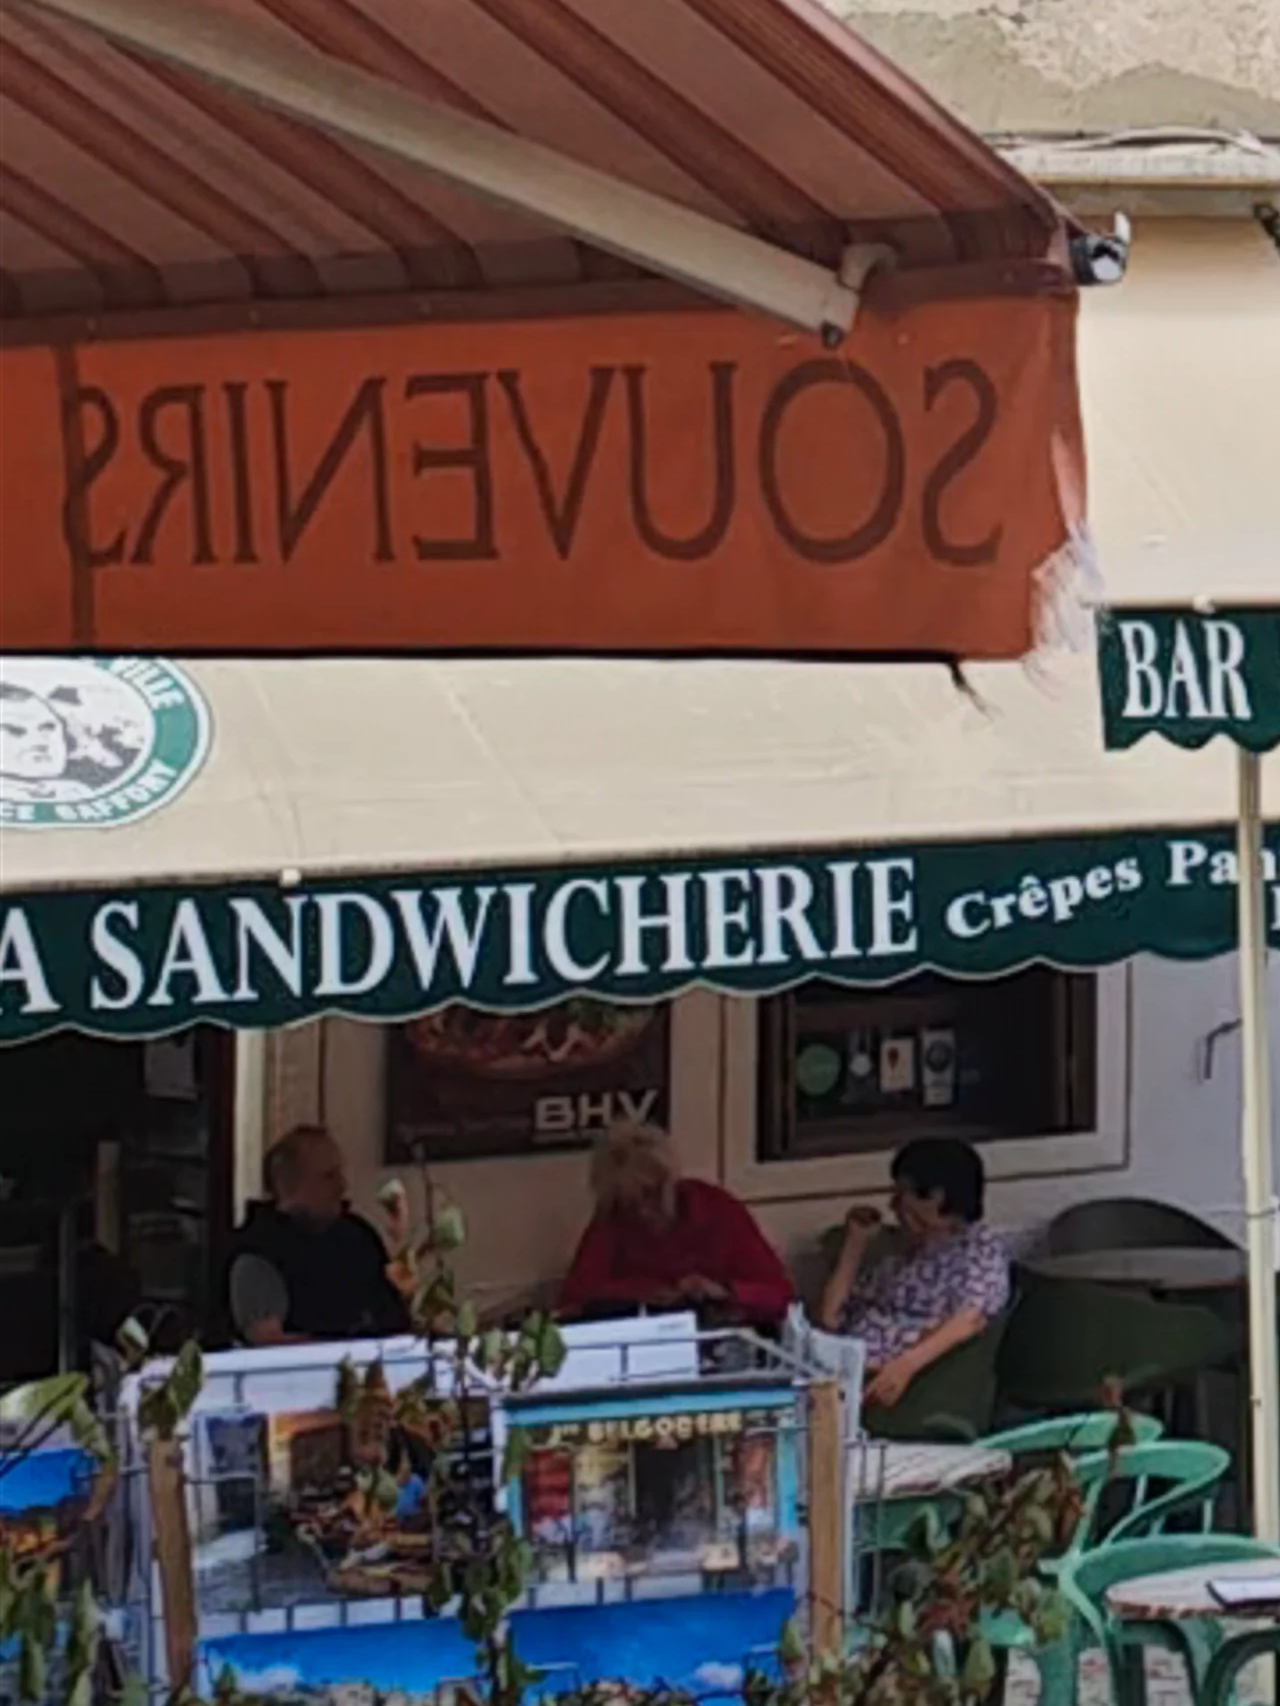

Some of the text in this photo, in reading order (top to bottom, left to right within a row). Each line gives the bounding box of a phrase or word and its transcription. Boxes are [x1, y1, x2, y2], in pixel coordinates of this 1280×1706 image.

[1119, 618, 1253, 722] BAR
[89, 855, 918, 1011] SANDWICHERIE
[945, 850, 1142, 939] Crêpes
[534, 1089, 660, 1132] BHV
